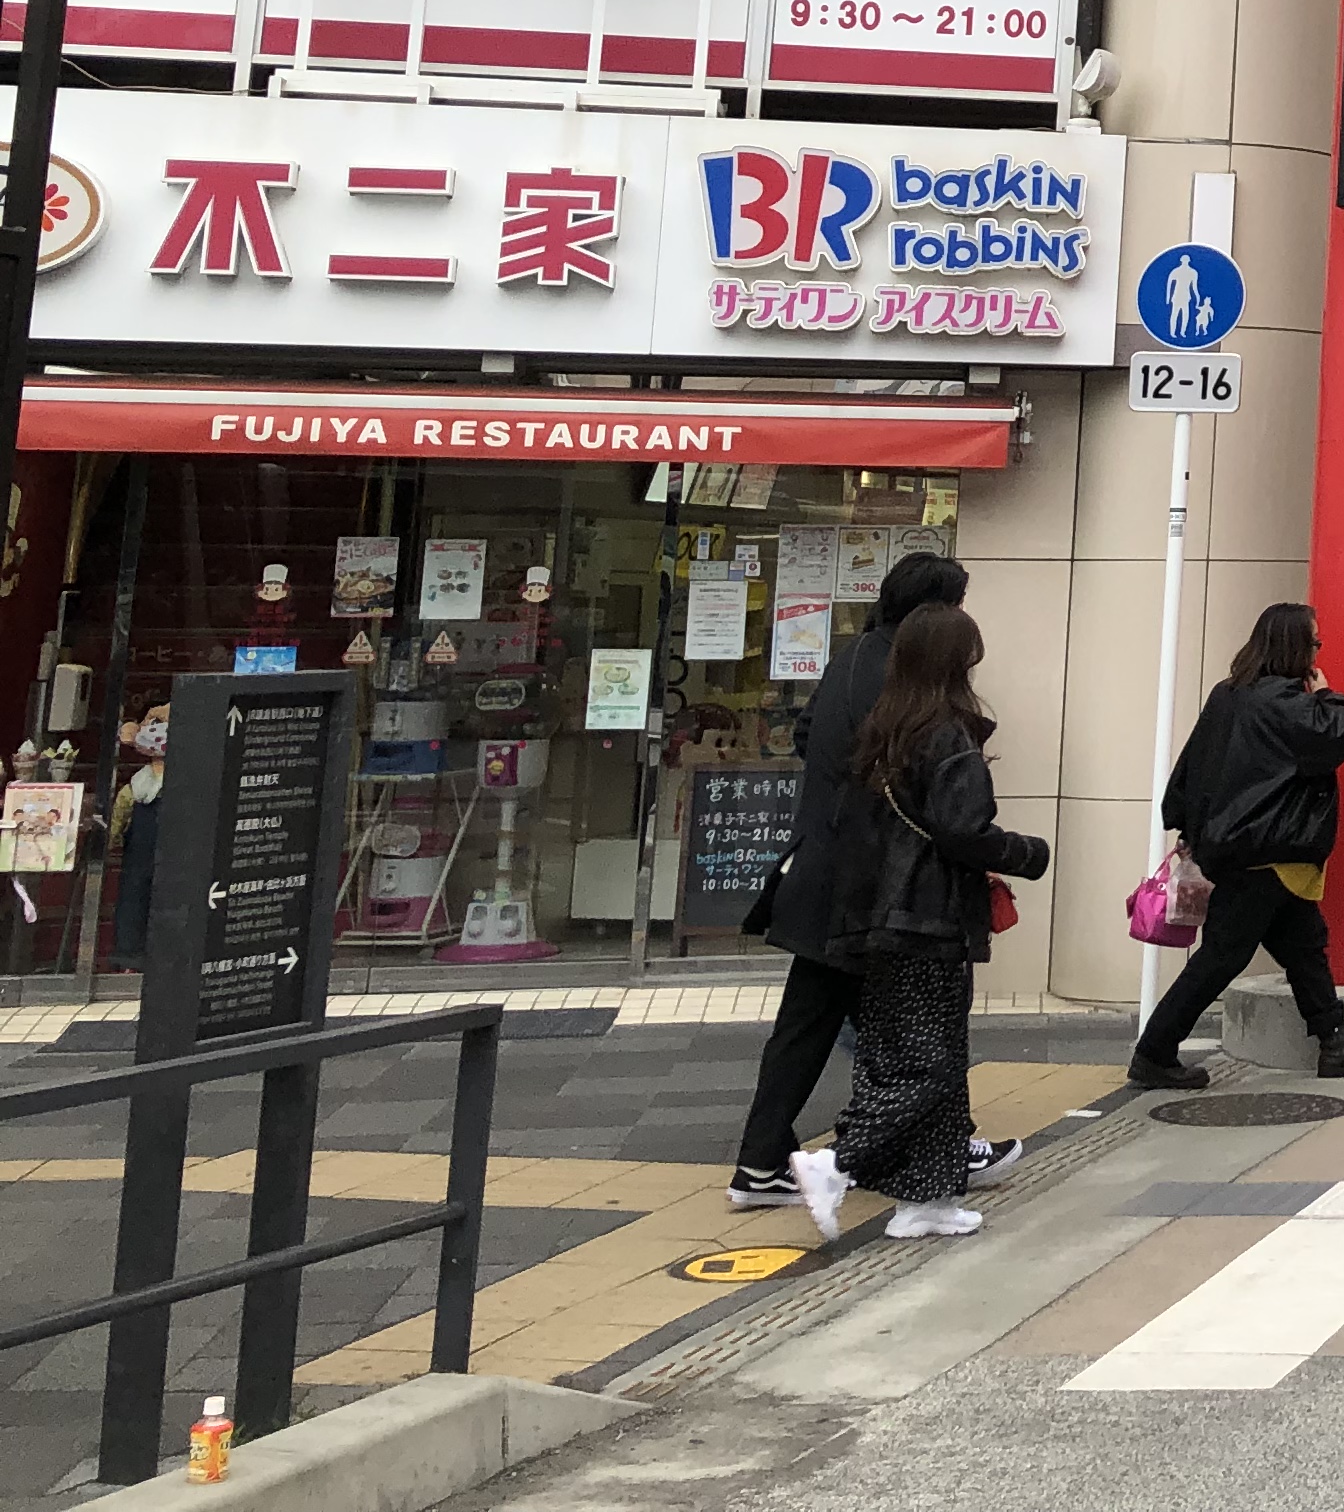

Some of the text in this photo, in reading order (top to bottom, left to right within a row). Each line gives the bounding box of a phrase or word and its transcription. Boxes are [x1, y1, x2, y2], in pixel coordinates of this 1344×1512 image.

[892, 155, 1086, 215] baskin
[147, 158, 626, 289] 不二家
[704, 150, 875, 264] BR
[893, 220, 1083, 275] robbins
[710, 284, 1062, 333] サーティワン アイスクリーム
[1140, 365, 1233, 401] 12-16
[211, 414, 743, 452] FUJIYA RESTAURANT
[852, 582, 876, 593] 390
[791, 661, 817, 673] 108
[706, 777, 797, 802] 営業時間
